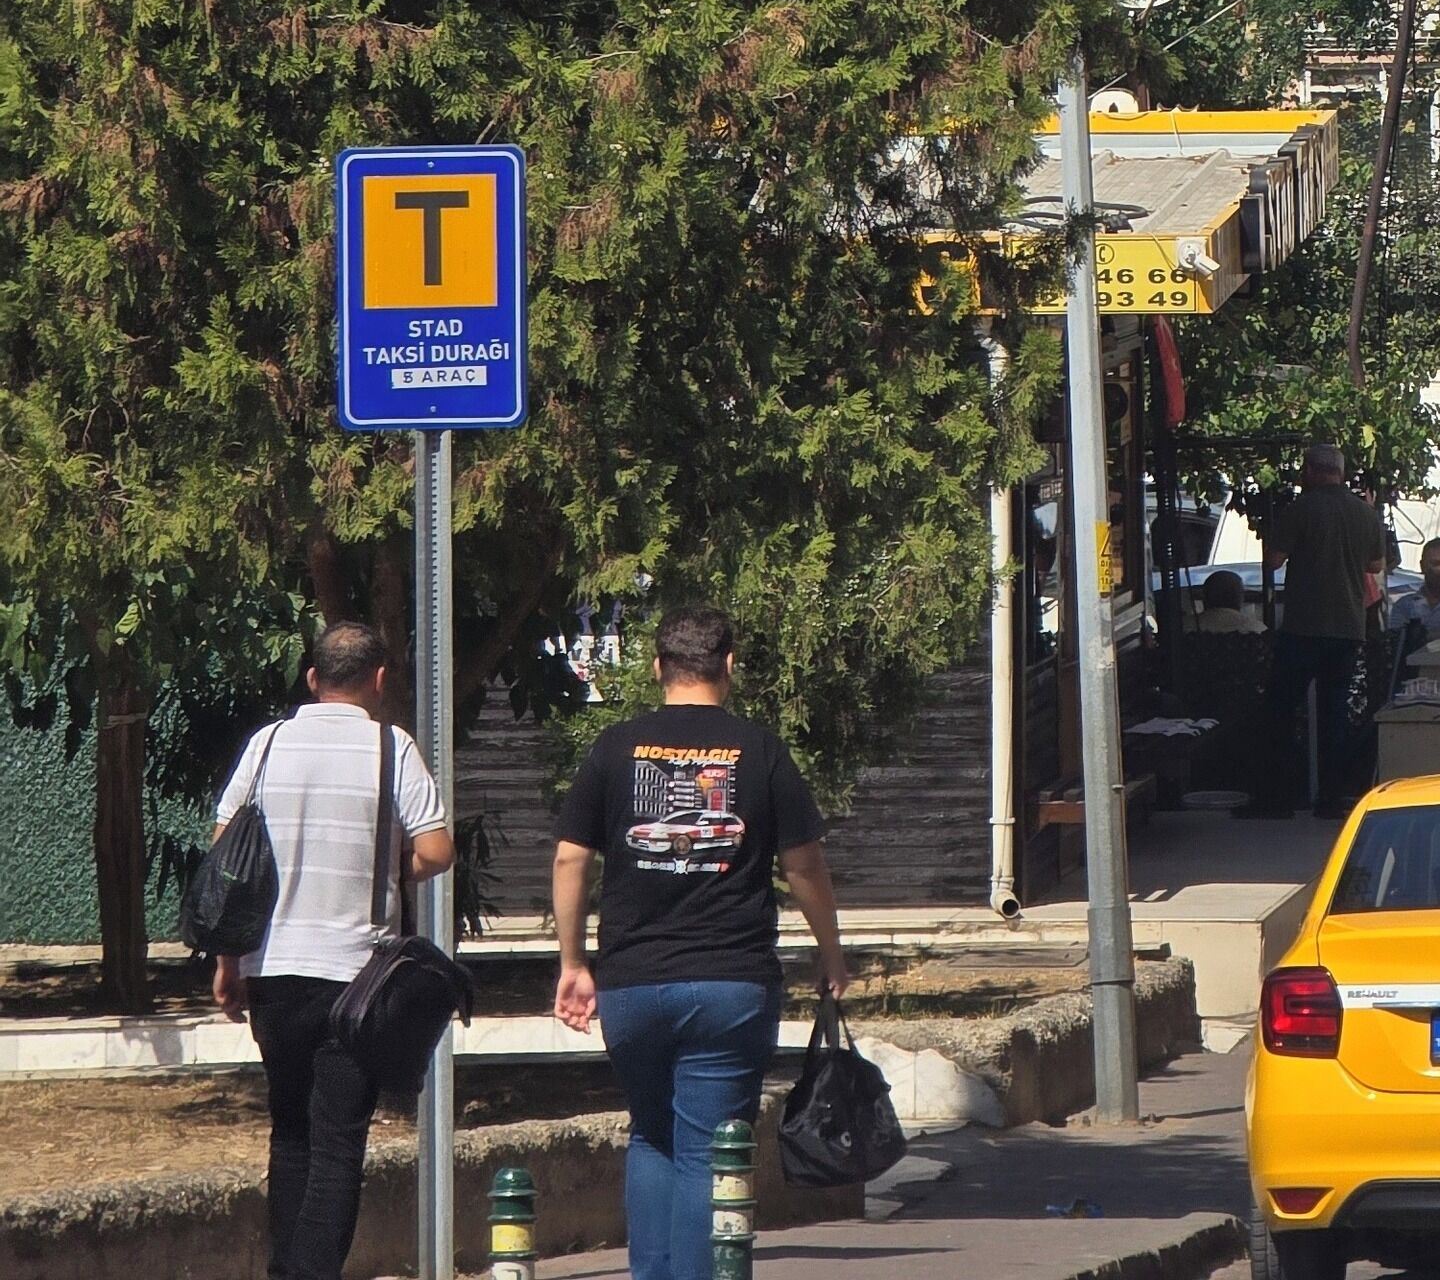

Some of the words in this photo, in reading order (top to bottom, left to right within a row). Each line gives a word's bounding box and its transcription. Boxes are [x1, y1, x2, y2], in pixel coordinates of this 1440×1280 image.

[395, 190, 469, 286] T
[1097, 269, 1134, 284] 46
[1148, 268, 1188, 284] 66
[1099, 291, 1134, 307] 93
[1148, 291, 1188, 307] 49
[408, 319, 463, 338] STAD
[363, 341, 425, 365] TAKSİ
[431, 338, 510, 363] DURAĞI
[422, 369, 476, 383] ARAÇ
[633, 745, 741, 765] NOSTALGIC
[1347, 990, 1399, 998] RENAULT
